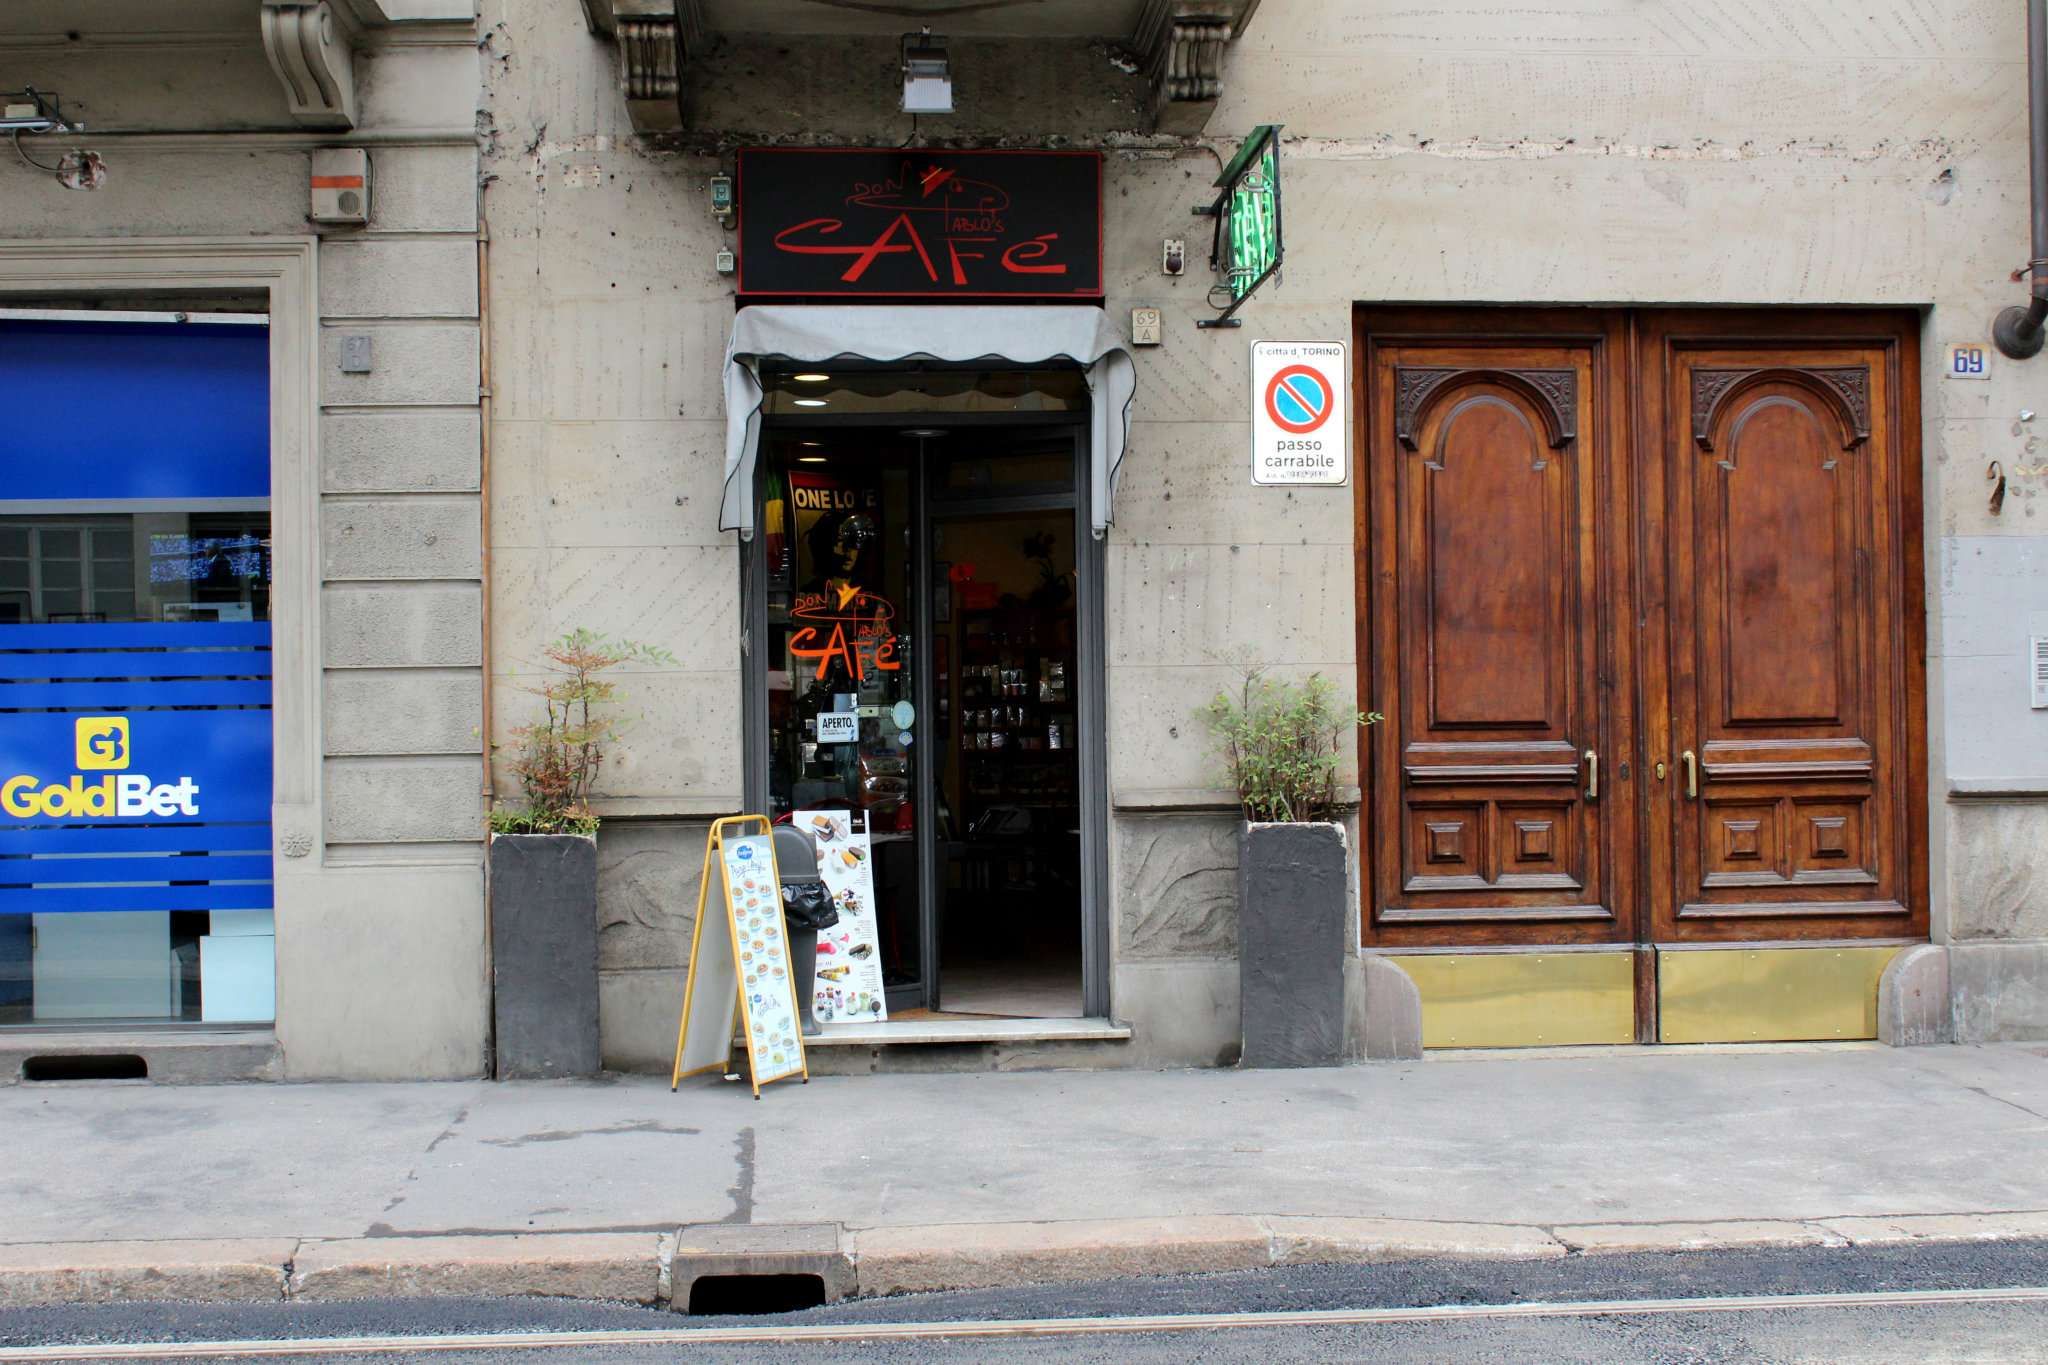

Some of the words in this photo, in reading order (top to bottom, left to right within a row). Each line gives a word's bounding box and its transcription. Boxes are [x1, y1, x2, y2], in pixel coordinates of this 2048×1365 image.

[854, 168, 908, 195] DON
[1136, 311, 1156, 325] 69
[1302, 347, 1341, 356] TORINO
[1953, 348, 1983, 373] 69
[1277, 440, 1322, 452] passo
[1265, 454, 1335, 468] carrabile
[794, 488, 832, 509] ONE
[833, 489, 877, 509] LOE
[822, 717, 854, 729] APERTO.
[0, 774, 201, 819] GoldBet
